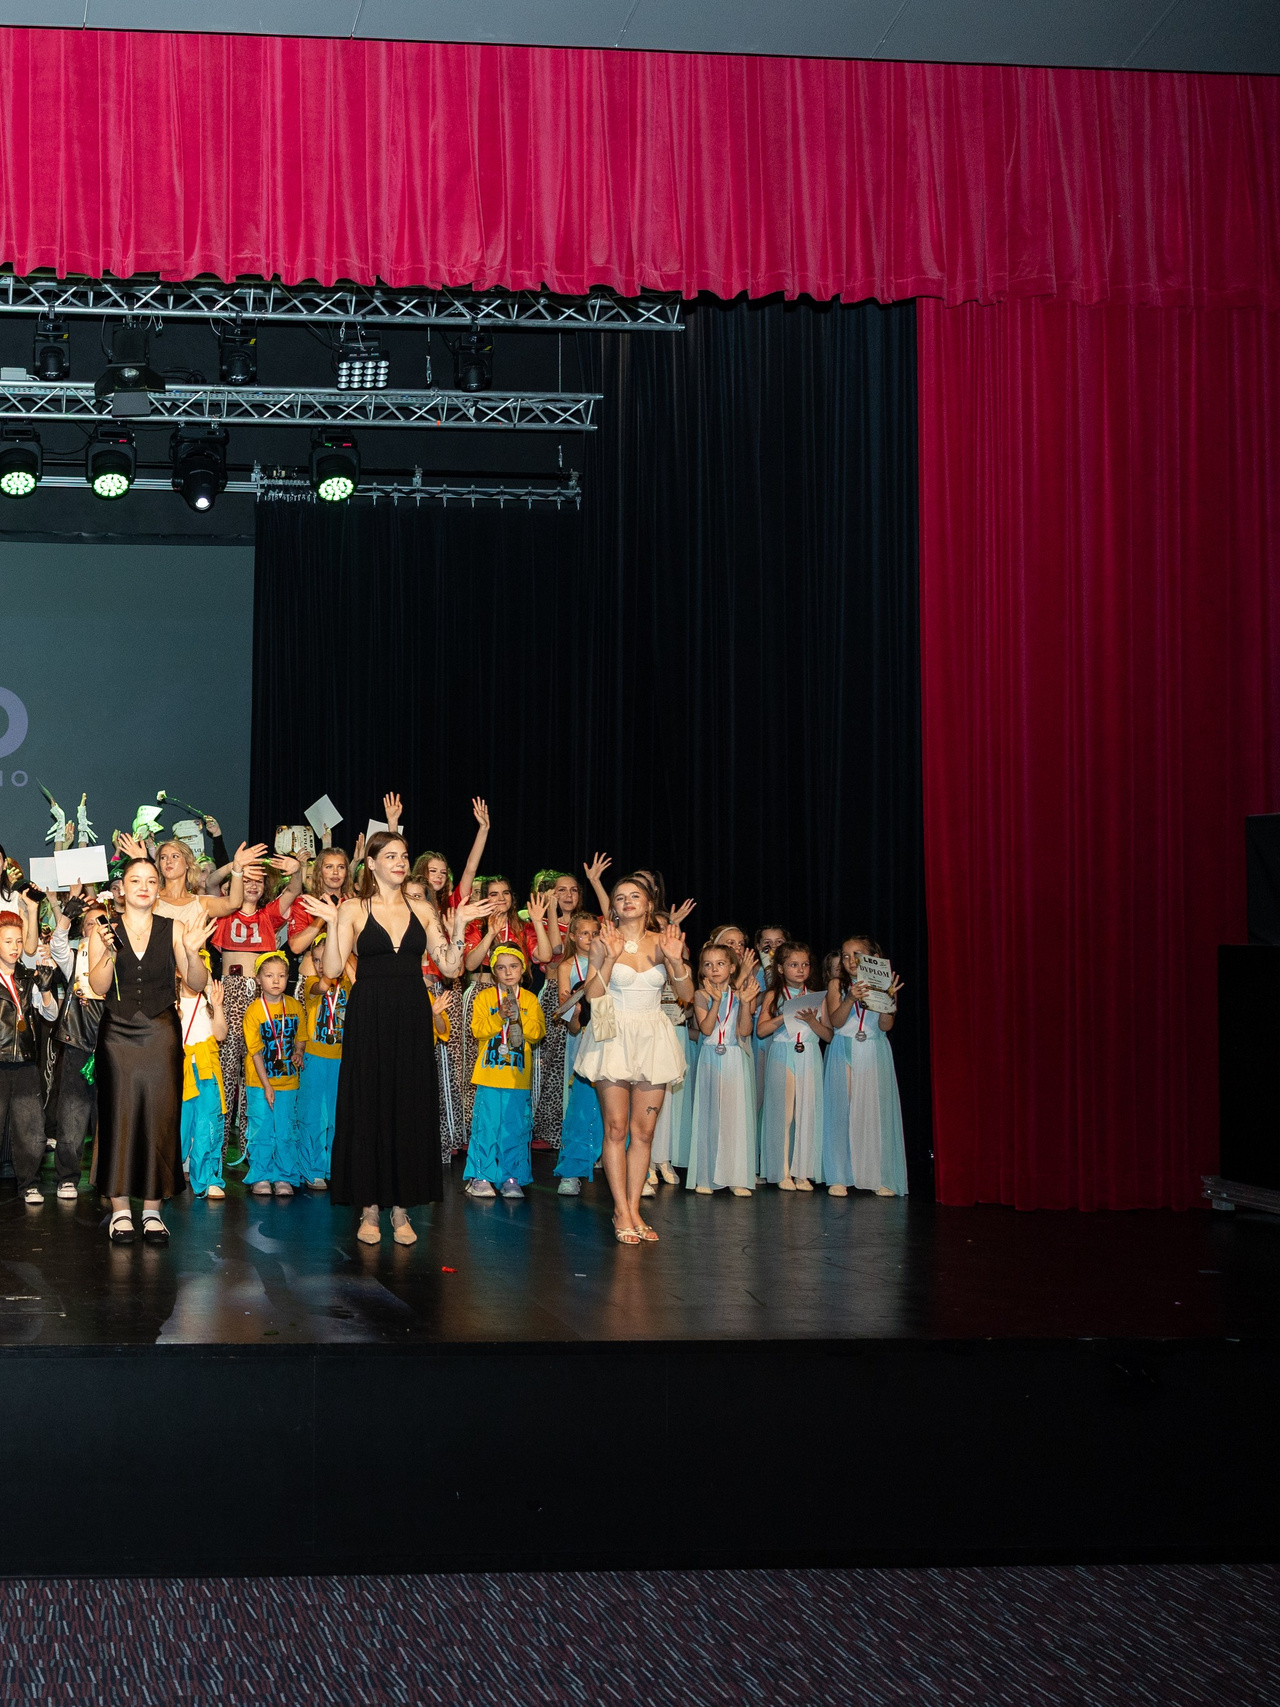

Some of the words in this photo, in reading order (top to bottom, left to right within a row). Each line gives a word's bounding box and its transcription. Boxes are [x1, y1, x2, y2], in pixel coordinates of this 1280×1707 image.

[230, 918, 262, 944] 01
[864, 957, 878, 965] LEO
[860, 965, 890, 978] DYPLOM
